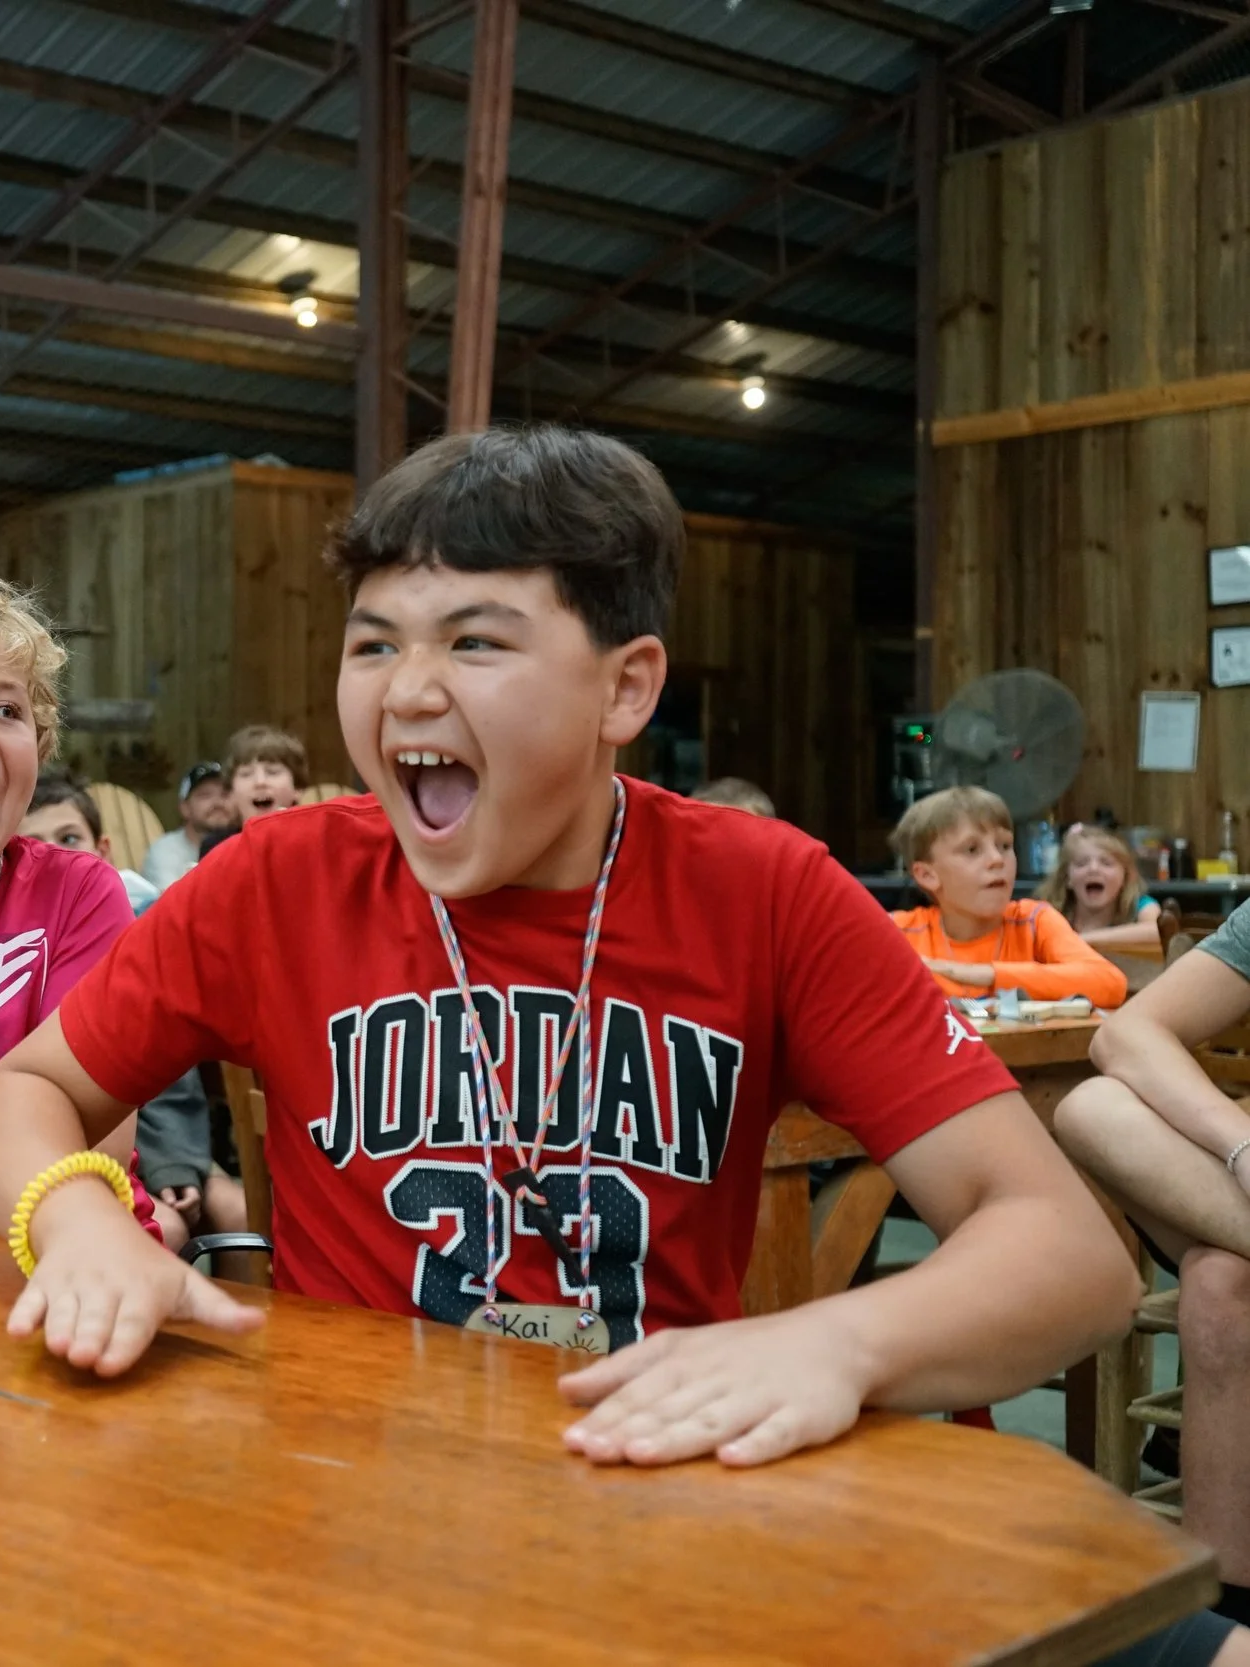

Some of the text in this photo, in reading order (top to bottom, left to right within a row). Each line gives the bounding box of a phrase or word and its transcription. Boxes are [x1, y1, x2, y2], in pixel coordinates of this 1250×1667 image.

[308, 984, 745, 1185] JORDAN
[383, 1159, 650, 1354] 23
[502, 1313, 550, 1340] Kai
